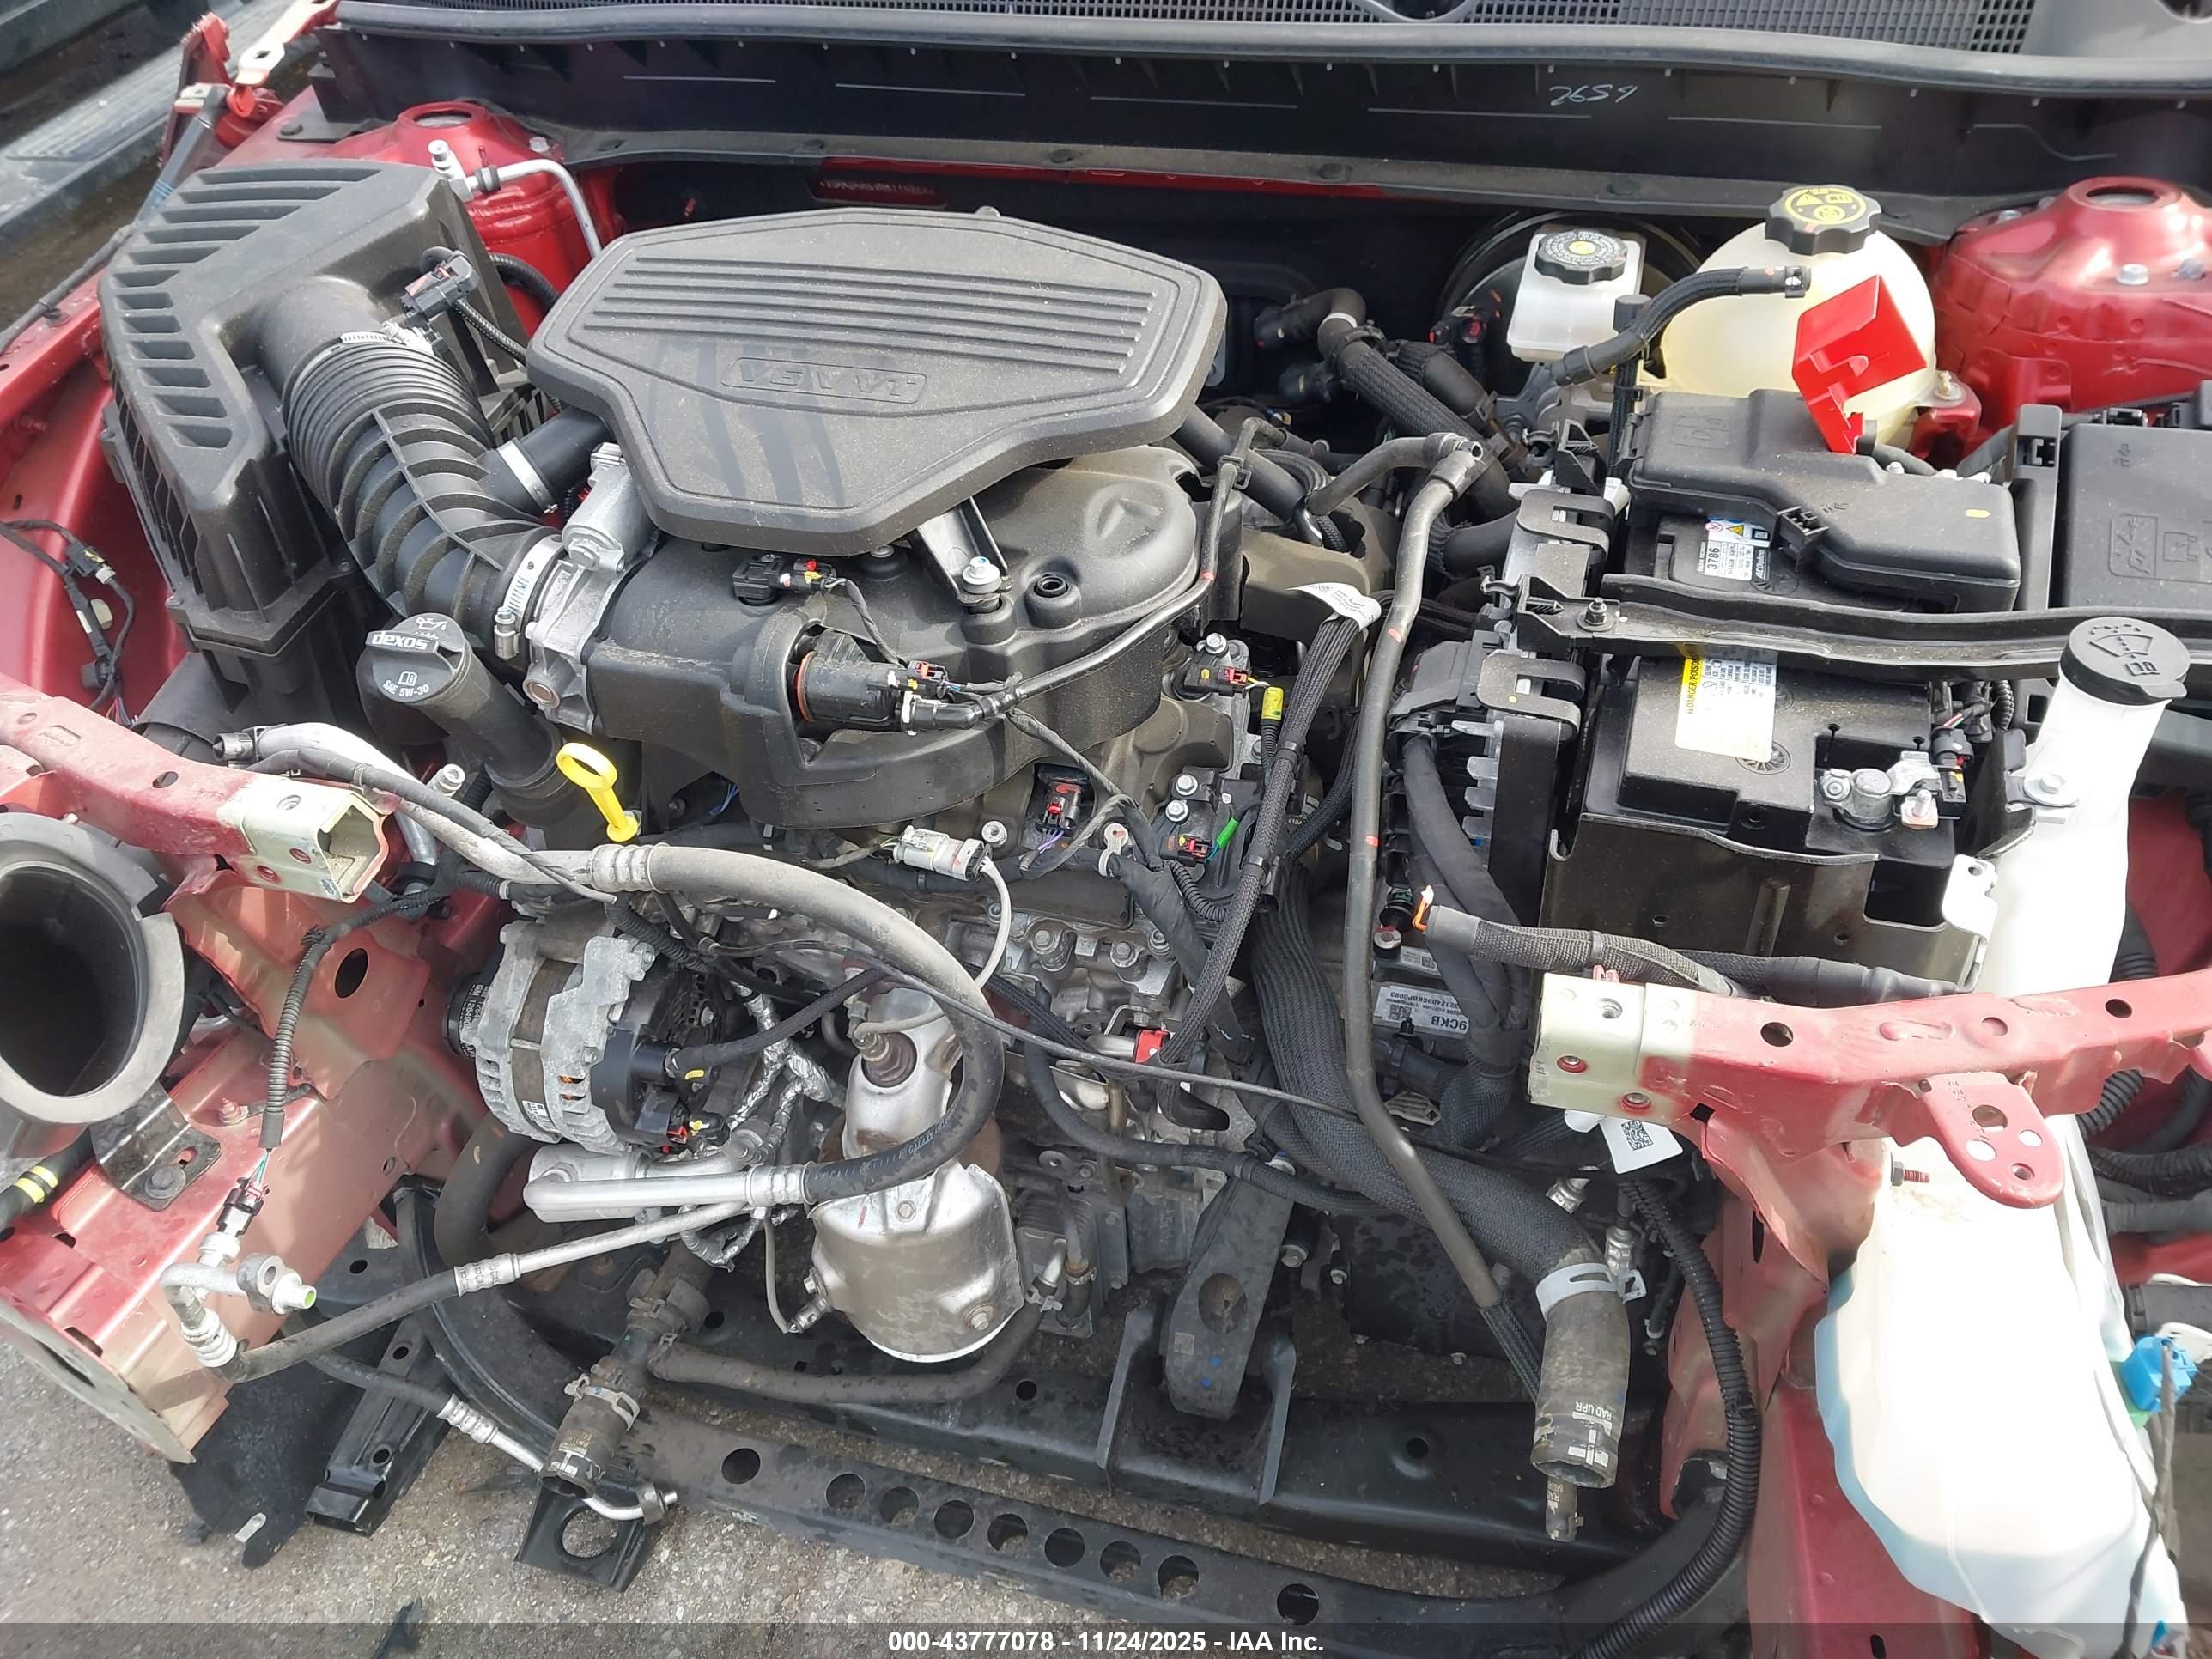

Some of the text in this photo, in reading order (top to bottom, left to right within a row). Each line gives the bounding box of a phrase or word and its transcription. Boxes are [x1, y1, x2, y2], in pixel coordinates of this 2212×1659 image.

[1706, 546, 1721, 570] 3786
[371, 630, 431, 651] dexos
[383, 679, 430, 697] SAE 5W-30
[471, 984, 484, 996] GM
[1430, 1015, 1468, 1031] 9CKB
[1575, 1401, 1613, 1421] RAD UPR
